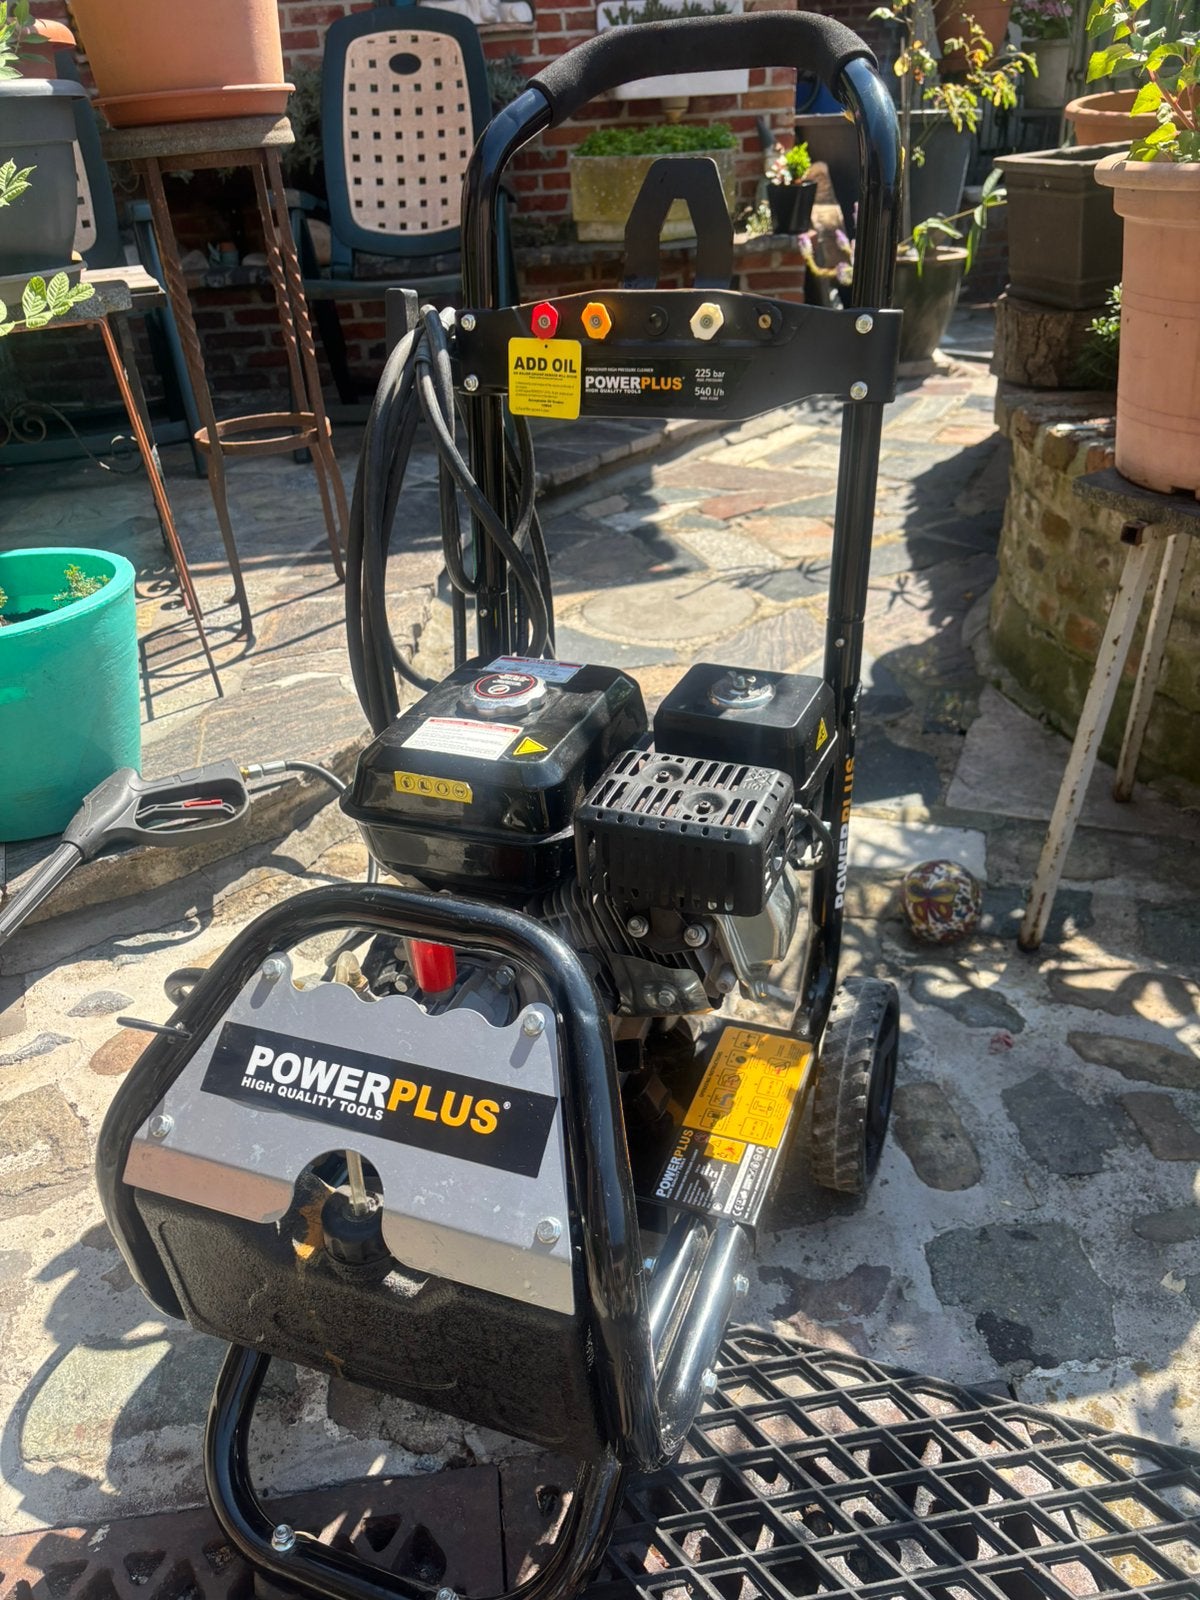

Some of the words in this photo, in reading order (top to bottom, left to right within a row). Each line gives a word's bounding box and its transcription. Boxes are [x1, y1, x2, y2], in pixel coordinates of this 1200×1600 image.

[514, 356, 547, 371] ADD
[552, 358, 577, 374] OIL
[694, 368, 711, 378] 225
[712, 369, 725, 378] bar
[585, 375, 683, 391] POWERPLUS
[694, 386, 711, 396] 540
[244, 1044, 501, 1134] POWERPLUS
[241, 1076, 275, 1094] HIGH
[277, 1085, 336, 1109] QUALITY
[339, 1100, 384, 1121] TOOLS
[656, 1129, 693, 1197] POWERPLUS
